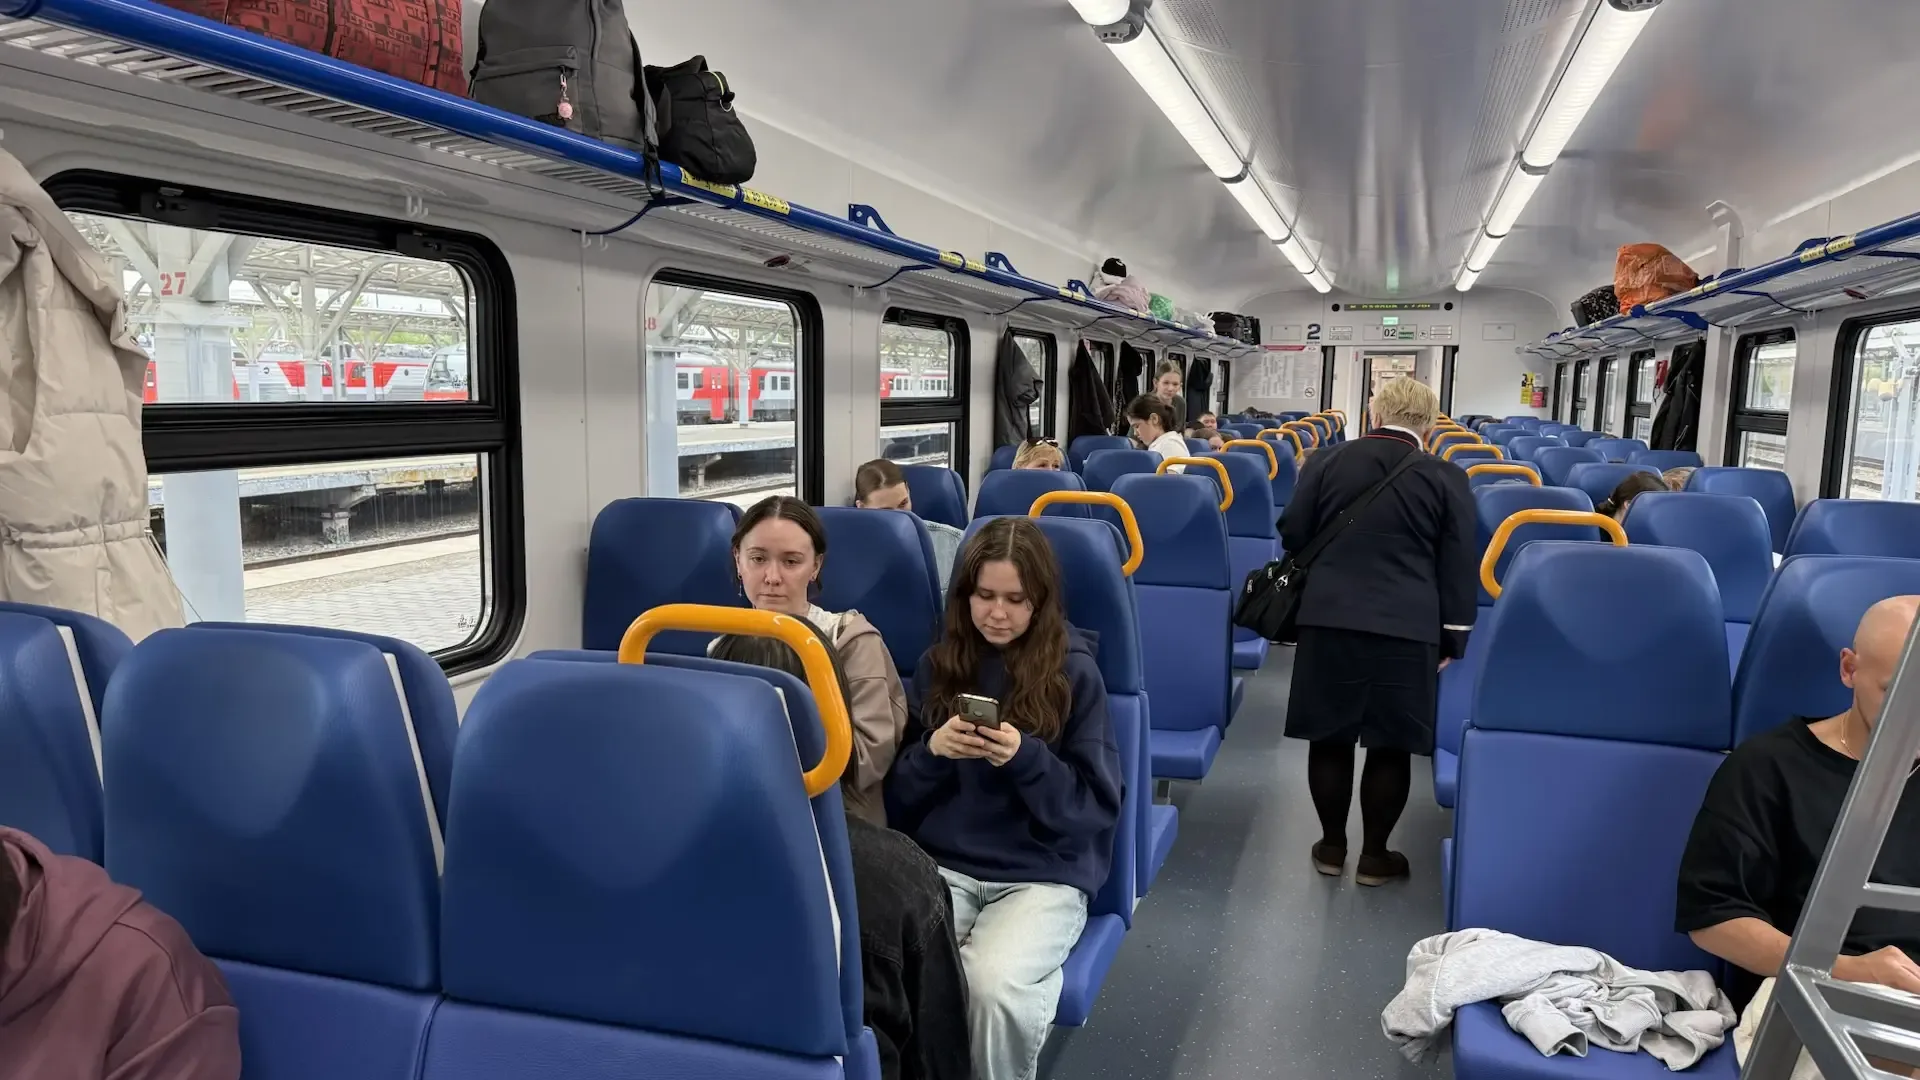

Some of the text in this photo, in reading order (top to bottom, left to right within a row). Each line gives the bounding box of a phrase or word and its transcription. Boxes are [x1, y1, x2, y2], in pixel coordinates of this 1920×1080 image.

[160, 272, 186, 296] 27
[645, 316, 657, 331] 8
[1307, 323, 1321, 340] 2
[1384, 328, 1396, 337] 02
